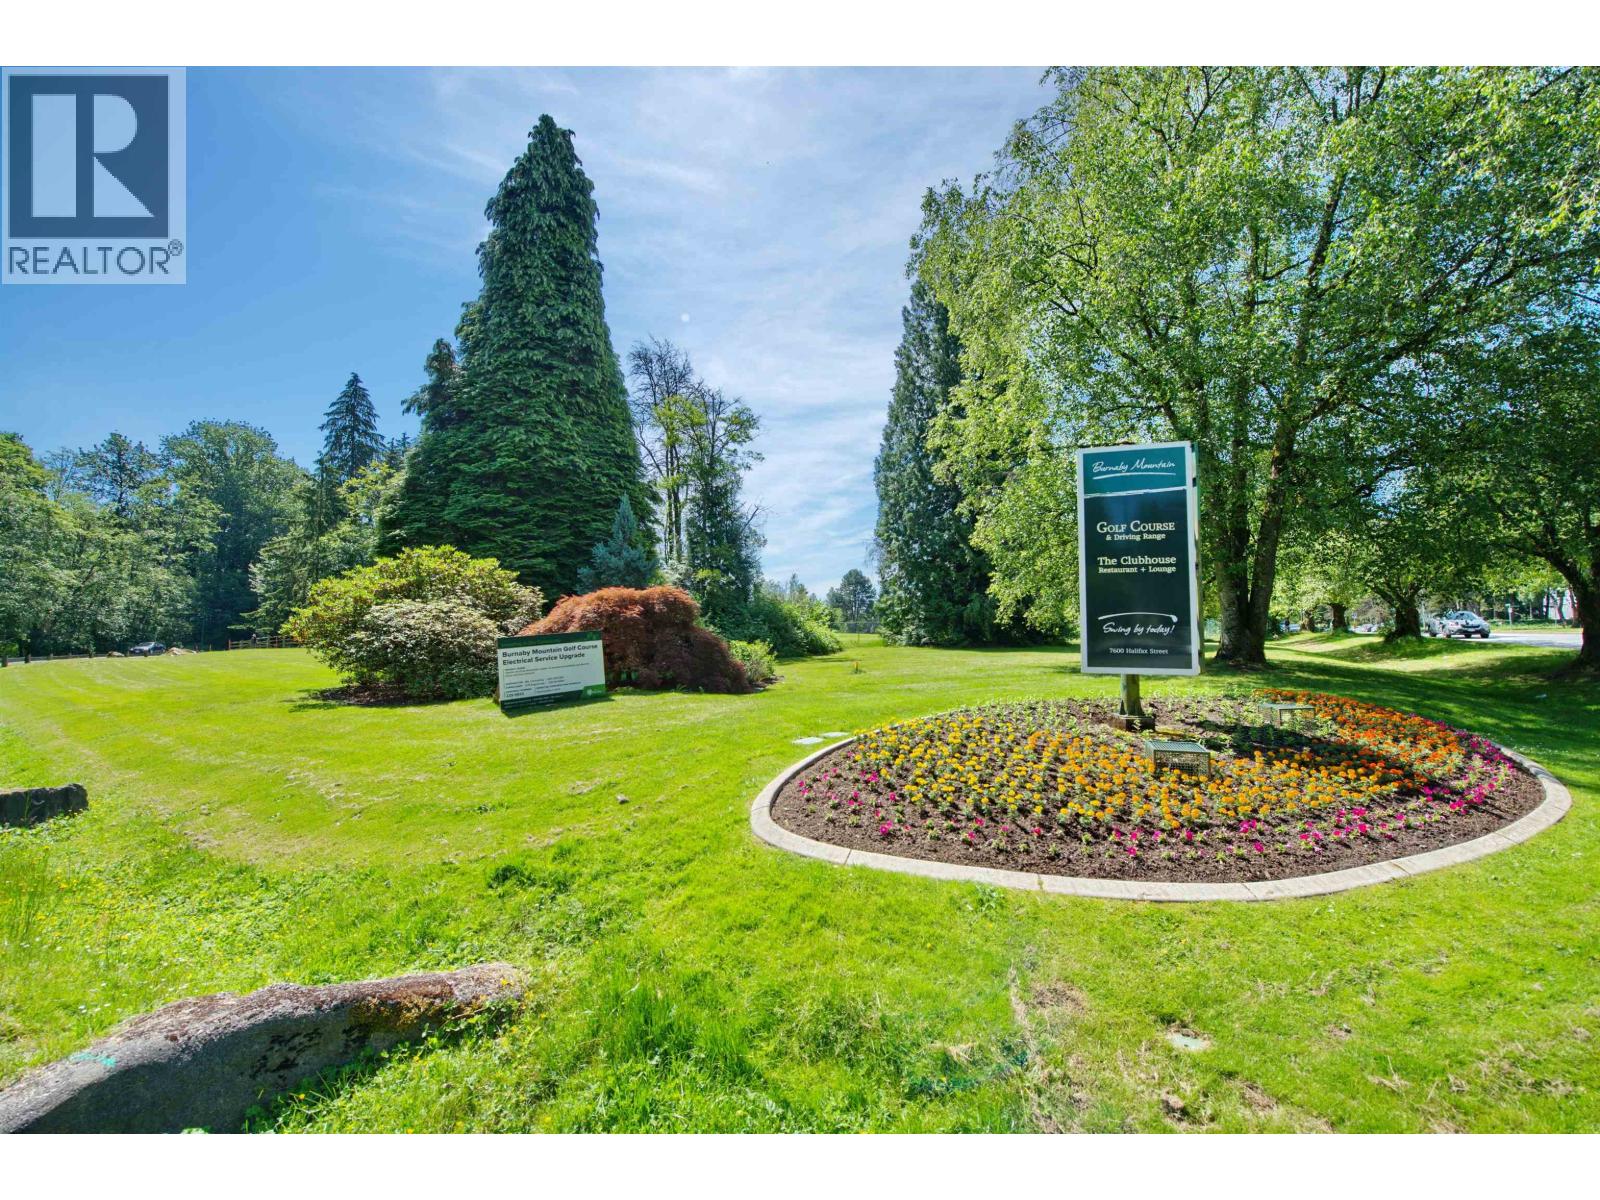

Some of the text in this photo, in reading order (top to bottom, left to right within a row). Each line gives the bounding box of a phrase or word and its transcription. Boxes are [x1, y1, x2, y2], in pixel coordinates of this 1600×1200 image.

[1092, 457, 1176, 473] Burnaby Mountain
[1114, 533, 1141, 542] Driving
[1143, 532, 1166, 541] Range
[1097, 555, 1177, 566] The Clubhouse
[1098, 566, 1138, 574] Restaurant
[1148, 565, 1177, 574] Lounge
[1102, 621, 1176, 636] Swing by today!
[502, 649, 531, 658] Burnaby
[532, 647, 562, 655] Mountain
[502, 652, 585, 666] Electrical Service Upgrade
